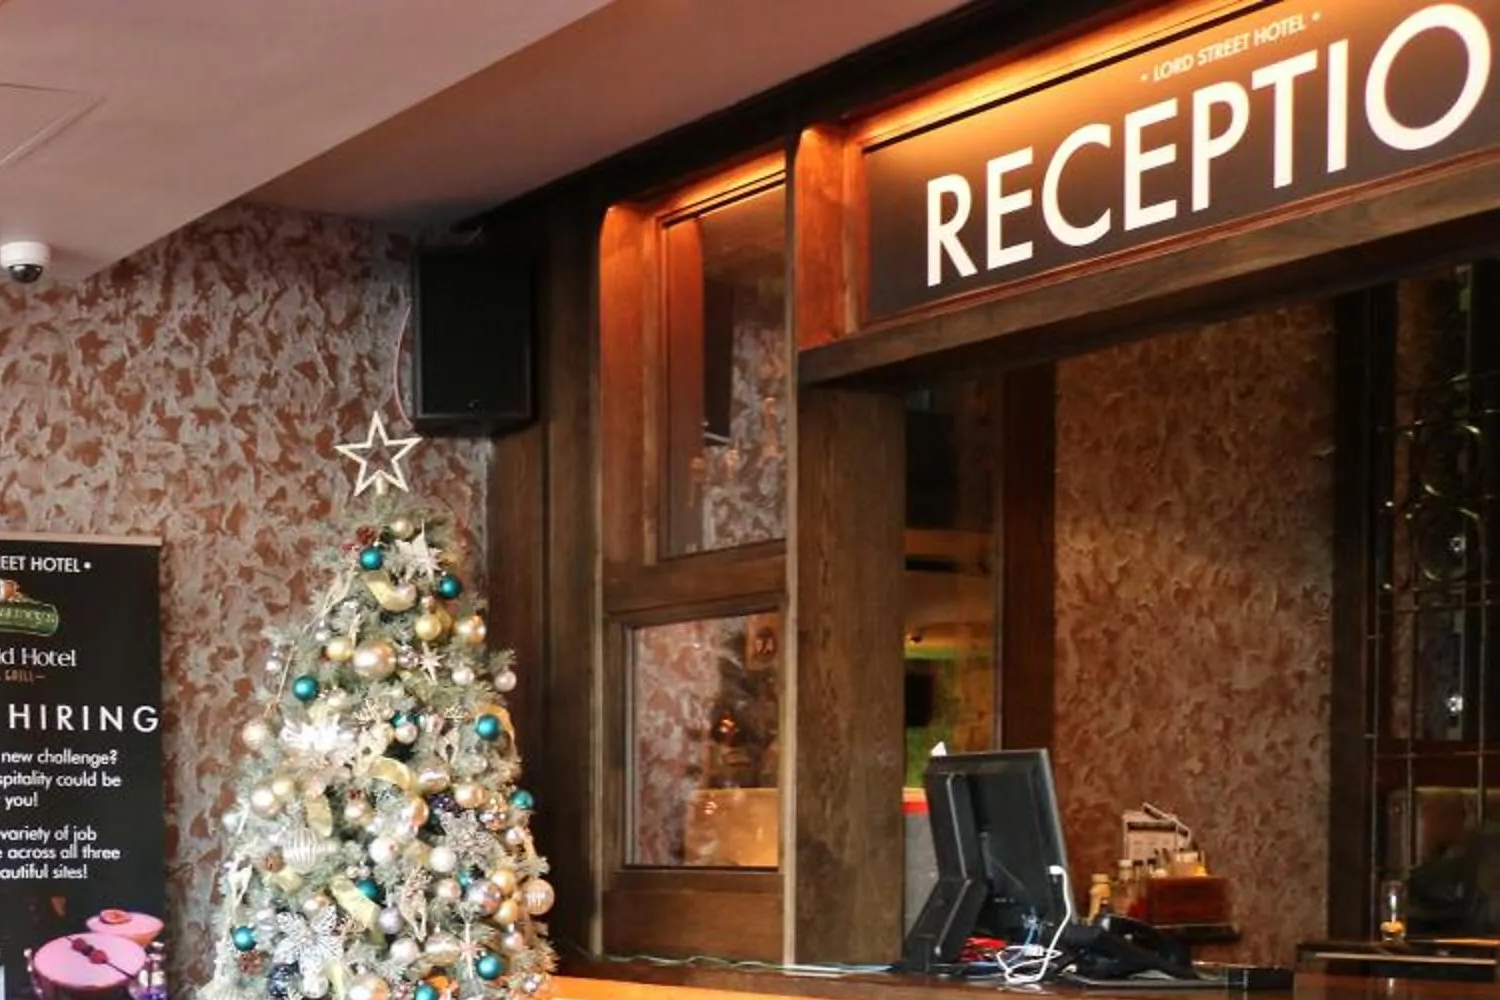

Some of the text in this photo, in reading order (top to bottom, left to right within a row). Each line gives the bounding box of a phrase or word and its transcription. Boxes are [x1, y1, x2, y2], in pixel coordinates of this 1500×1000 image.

[1153, 14, 1305, 82] LORD STREET HOTEL
[926, 3, 1491, 287] RECEPTIO
[31, 557, 81, 573] HOTEL
[22, 648, 76, 667] Hotel
[8, 704, 160, 733] HIRING
[1, 751, 32, 763] new
[37, 748, 118, 768] challenge?
[56, 771, 97, 787] could
[102, 771, 122, 787] be
[4, 792, 39, 811] you!
[0, 825, 51, 844] variety
[54, 825, 70, 841] of
[73, 825, 97, 843] job
[7, 847, 57, 860] across
[60, 844, 78, 860] all
[82, 844, 121, 860] three
[53, 863, 88, 880] sites!
